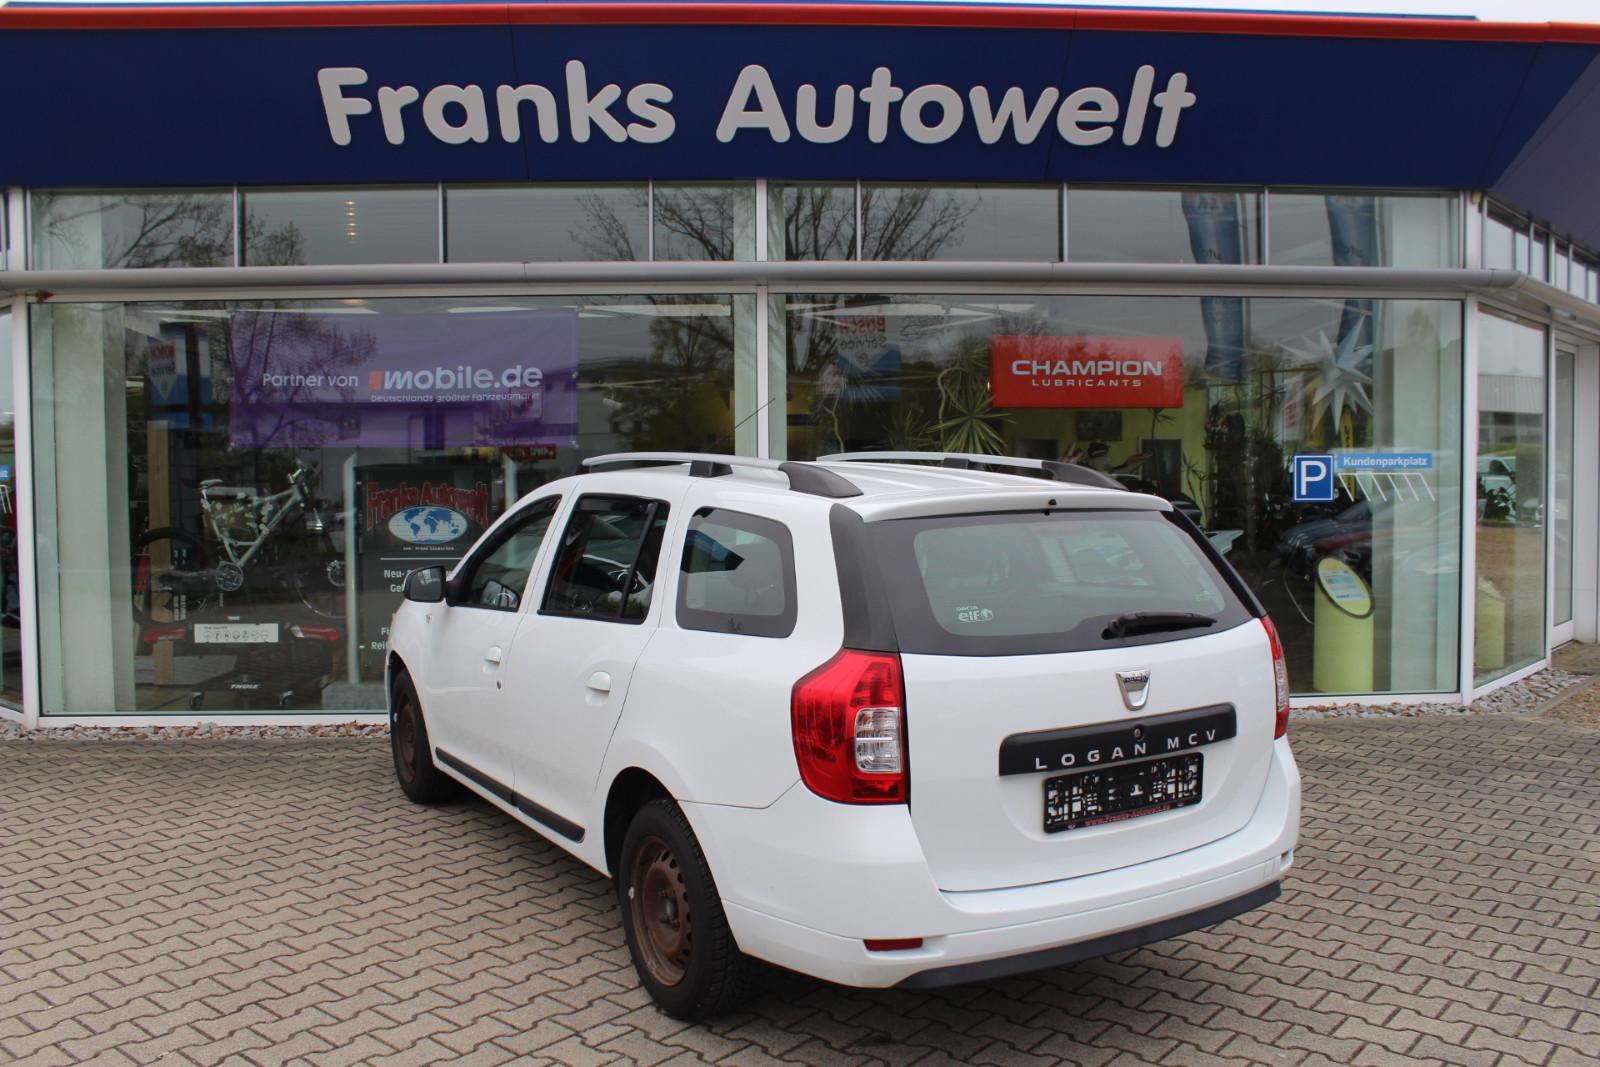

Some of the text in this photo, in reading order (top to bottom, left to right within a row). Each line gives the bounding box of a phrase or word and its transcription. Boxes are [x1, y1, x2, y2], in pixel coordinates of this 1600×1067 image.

[317, 60, 1196, 147] Franks Autowelt
[1011, 360, 1163, 377] CHAMPION
[262, 373, 359, 388] Partner von
[384, 365, 544, 390] mobile.de
[1032, 379, 1143, 388] LUBRICANTS
[370, 393, 433, 402] Deutschlands
[472, 392, 540, 402] Fahrzeugmarkt
[1343, 456, 1429, 468] Kundenparkplatz
[1301, 460, 1328, 496] P
[383, 569, 405, 579] Neu-
[1035, 729, 1217, 770] LOGAN MCV
